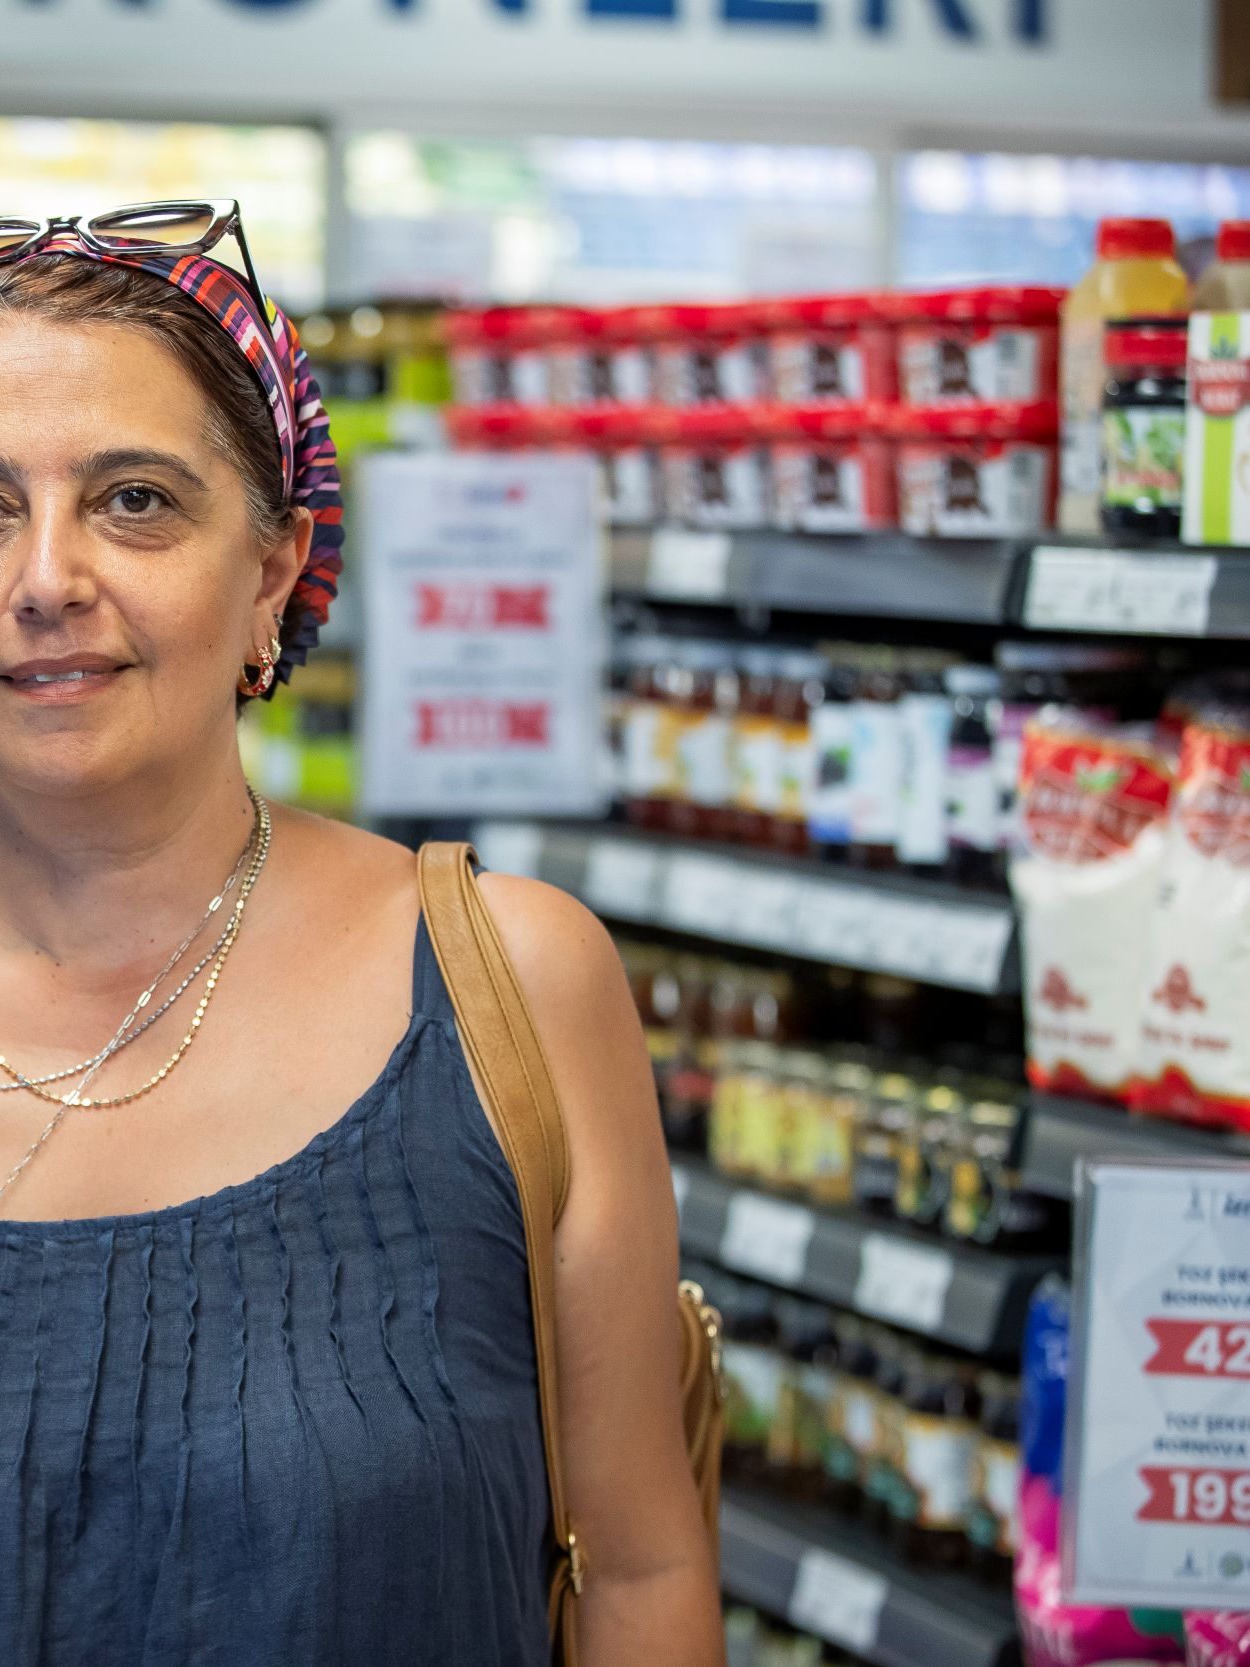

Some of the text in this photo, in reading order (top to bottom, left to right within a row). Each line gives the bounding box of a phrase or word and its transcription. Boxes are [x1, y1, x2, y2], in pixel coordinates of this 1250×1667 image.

[1183, 1326, 1250, 1373] 42
[1154, 1436, 1246, 1456] BORNOVA
[1169, 1471, 1250, 1521] 199
